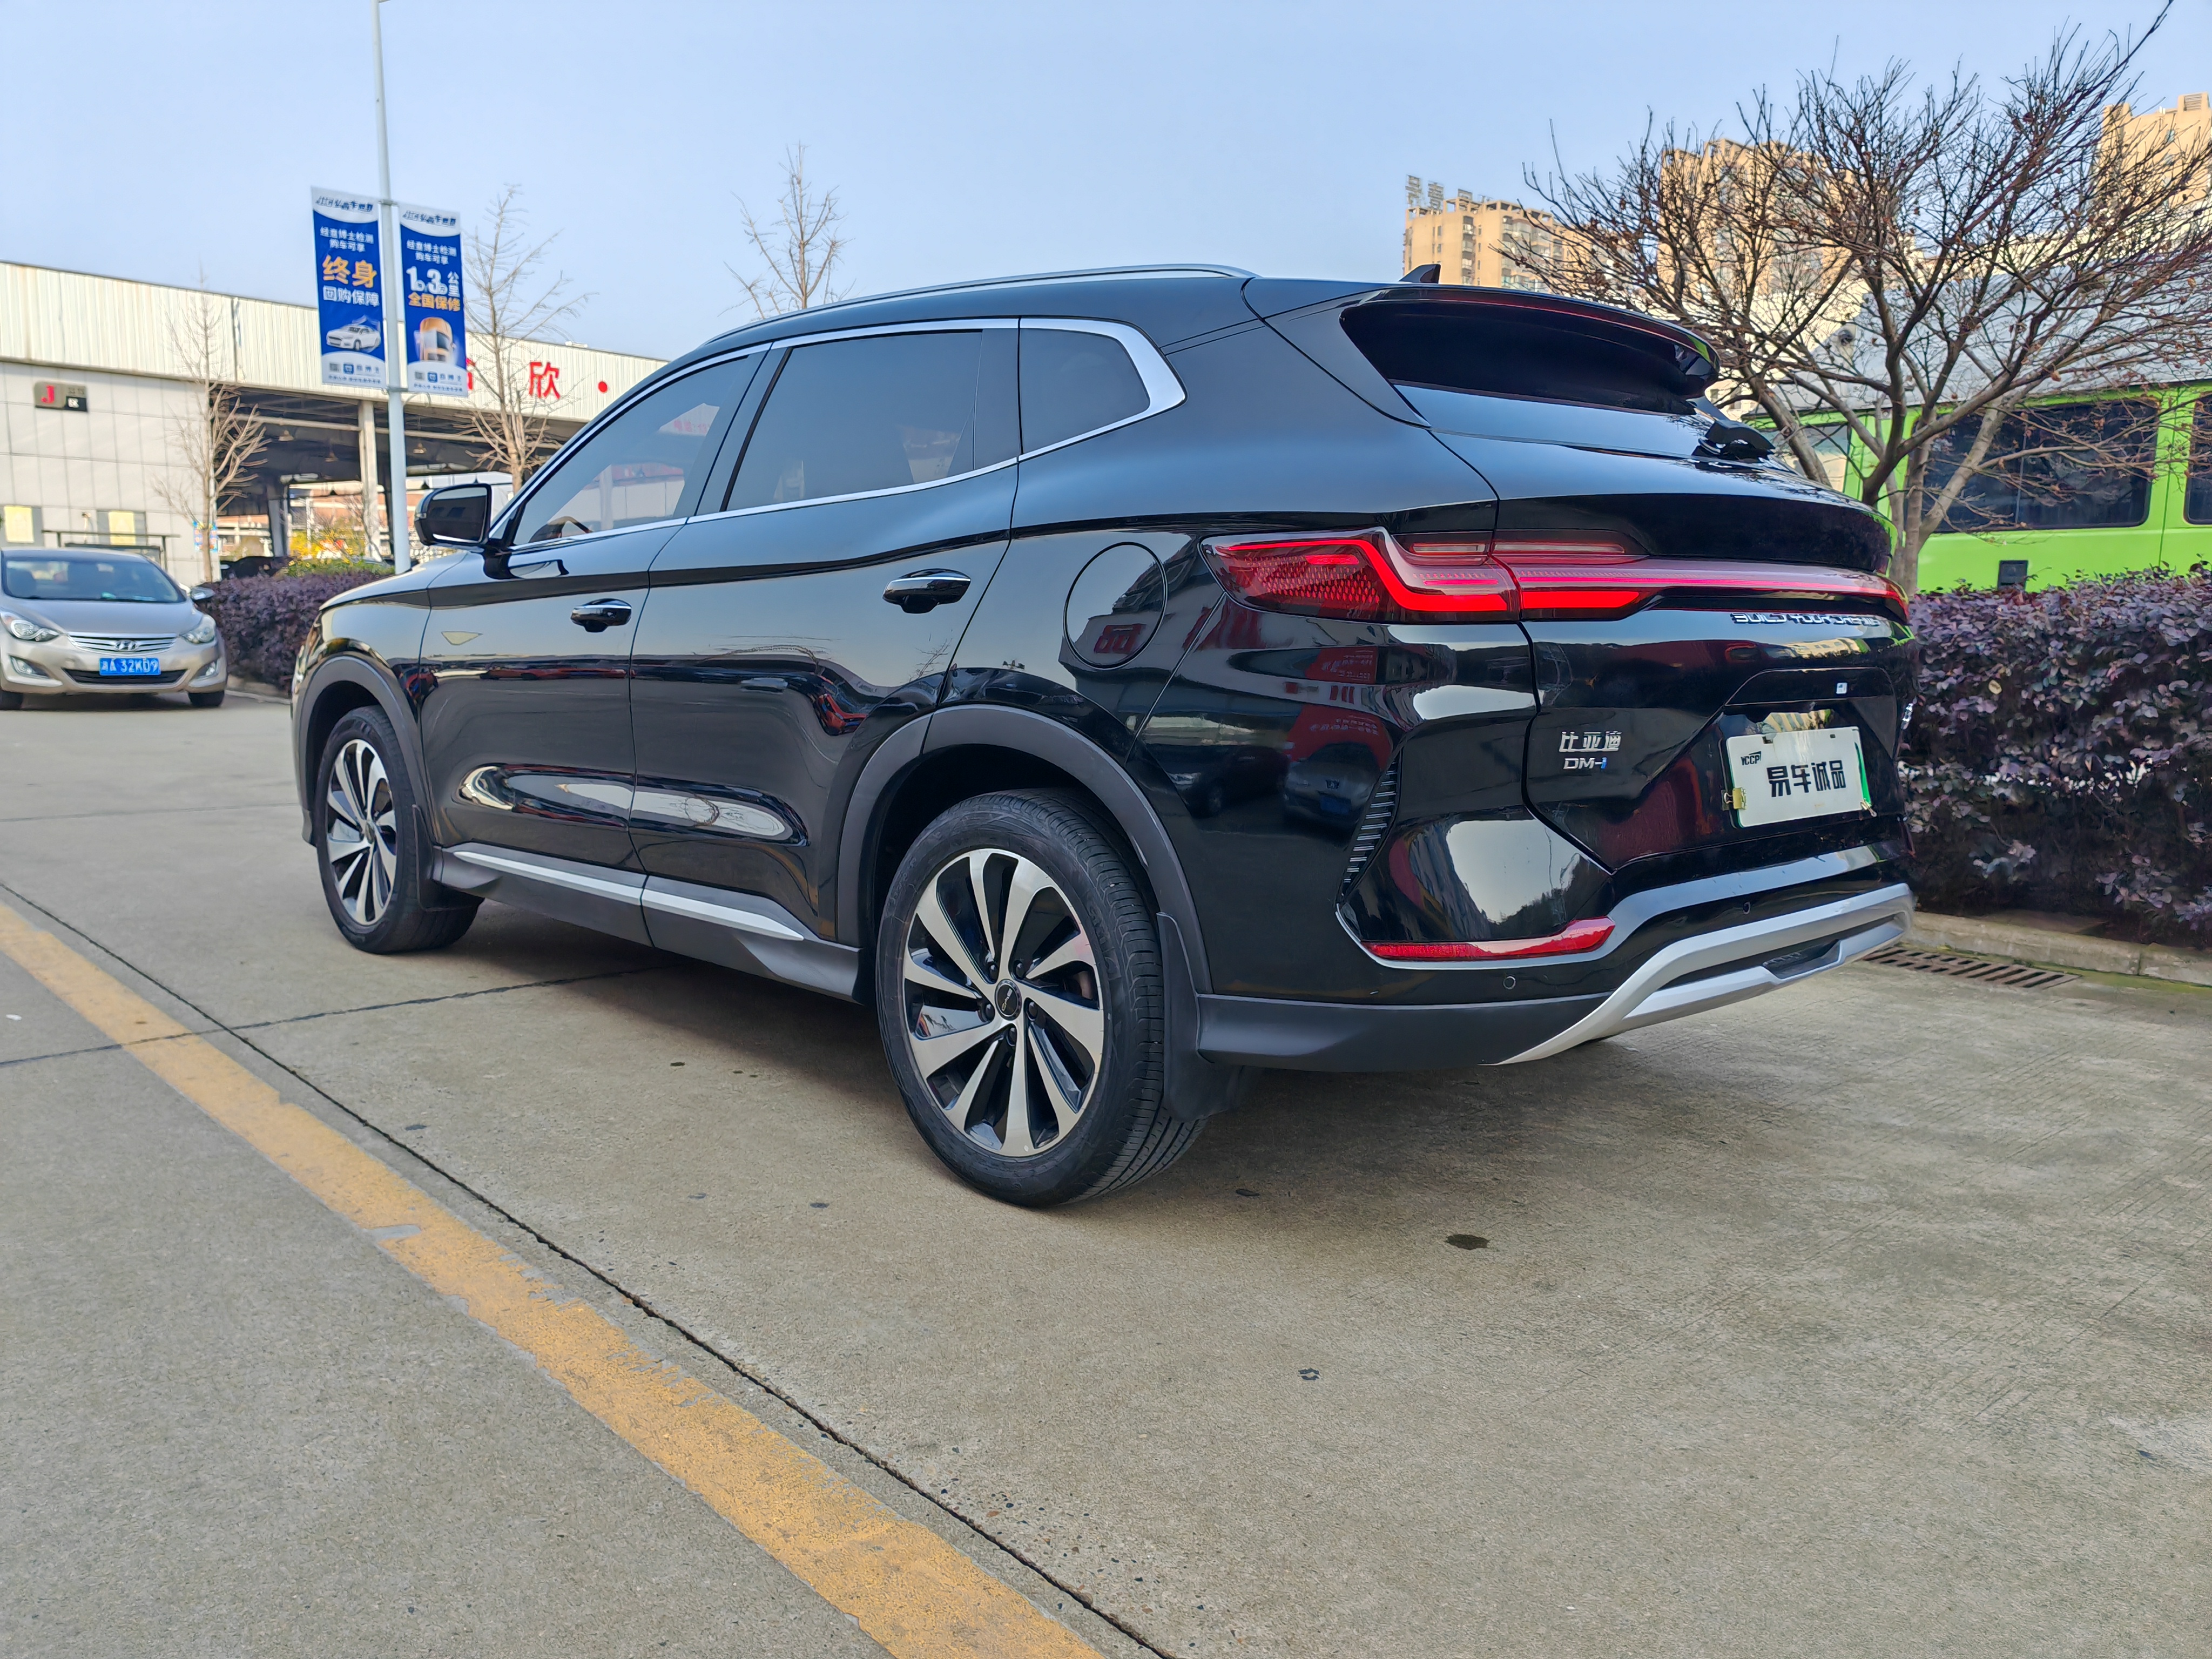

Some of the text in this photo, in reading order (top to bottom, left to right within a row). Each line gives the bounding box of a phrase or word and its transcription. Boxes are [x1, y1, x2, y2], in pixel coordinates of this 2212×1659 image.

[322, 254, 377, 288] 终身
[323, 285, 380, 307] 回购保障
[408, 292, 461, 312] 全国保修
[1559, 731, 1622, 752] 比亚迪
[1563, 757, 1608, 770] DM-i
[1741, 754, 1761, 766] YCCP
[1766, 760, 1846, 798] 易车诚品
